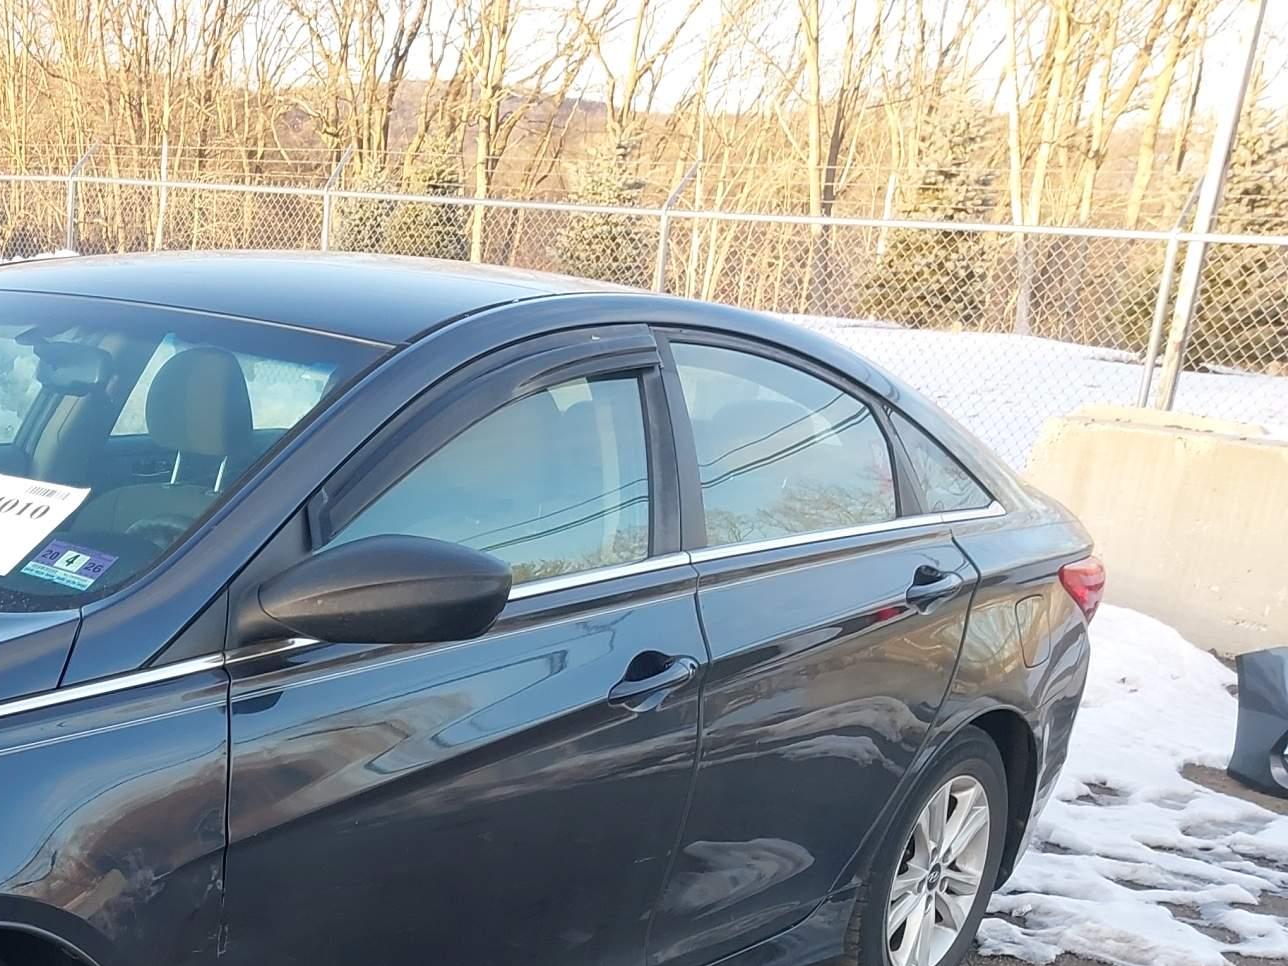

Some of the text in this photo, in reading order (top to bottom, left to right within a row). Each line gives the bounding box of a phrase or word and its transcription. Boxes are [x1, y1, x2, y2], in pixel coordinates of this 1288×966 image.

[42, 549, 60, 561] 20
[65, 554, 81, 567] 4
[83, 562, 104, 573] 26
